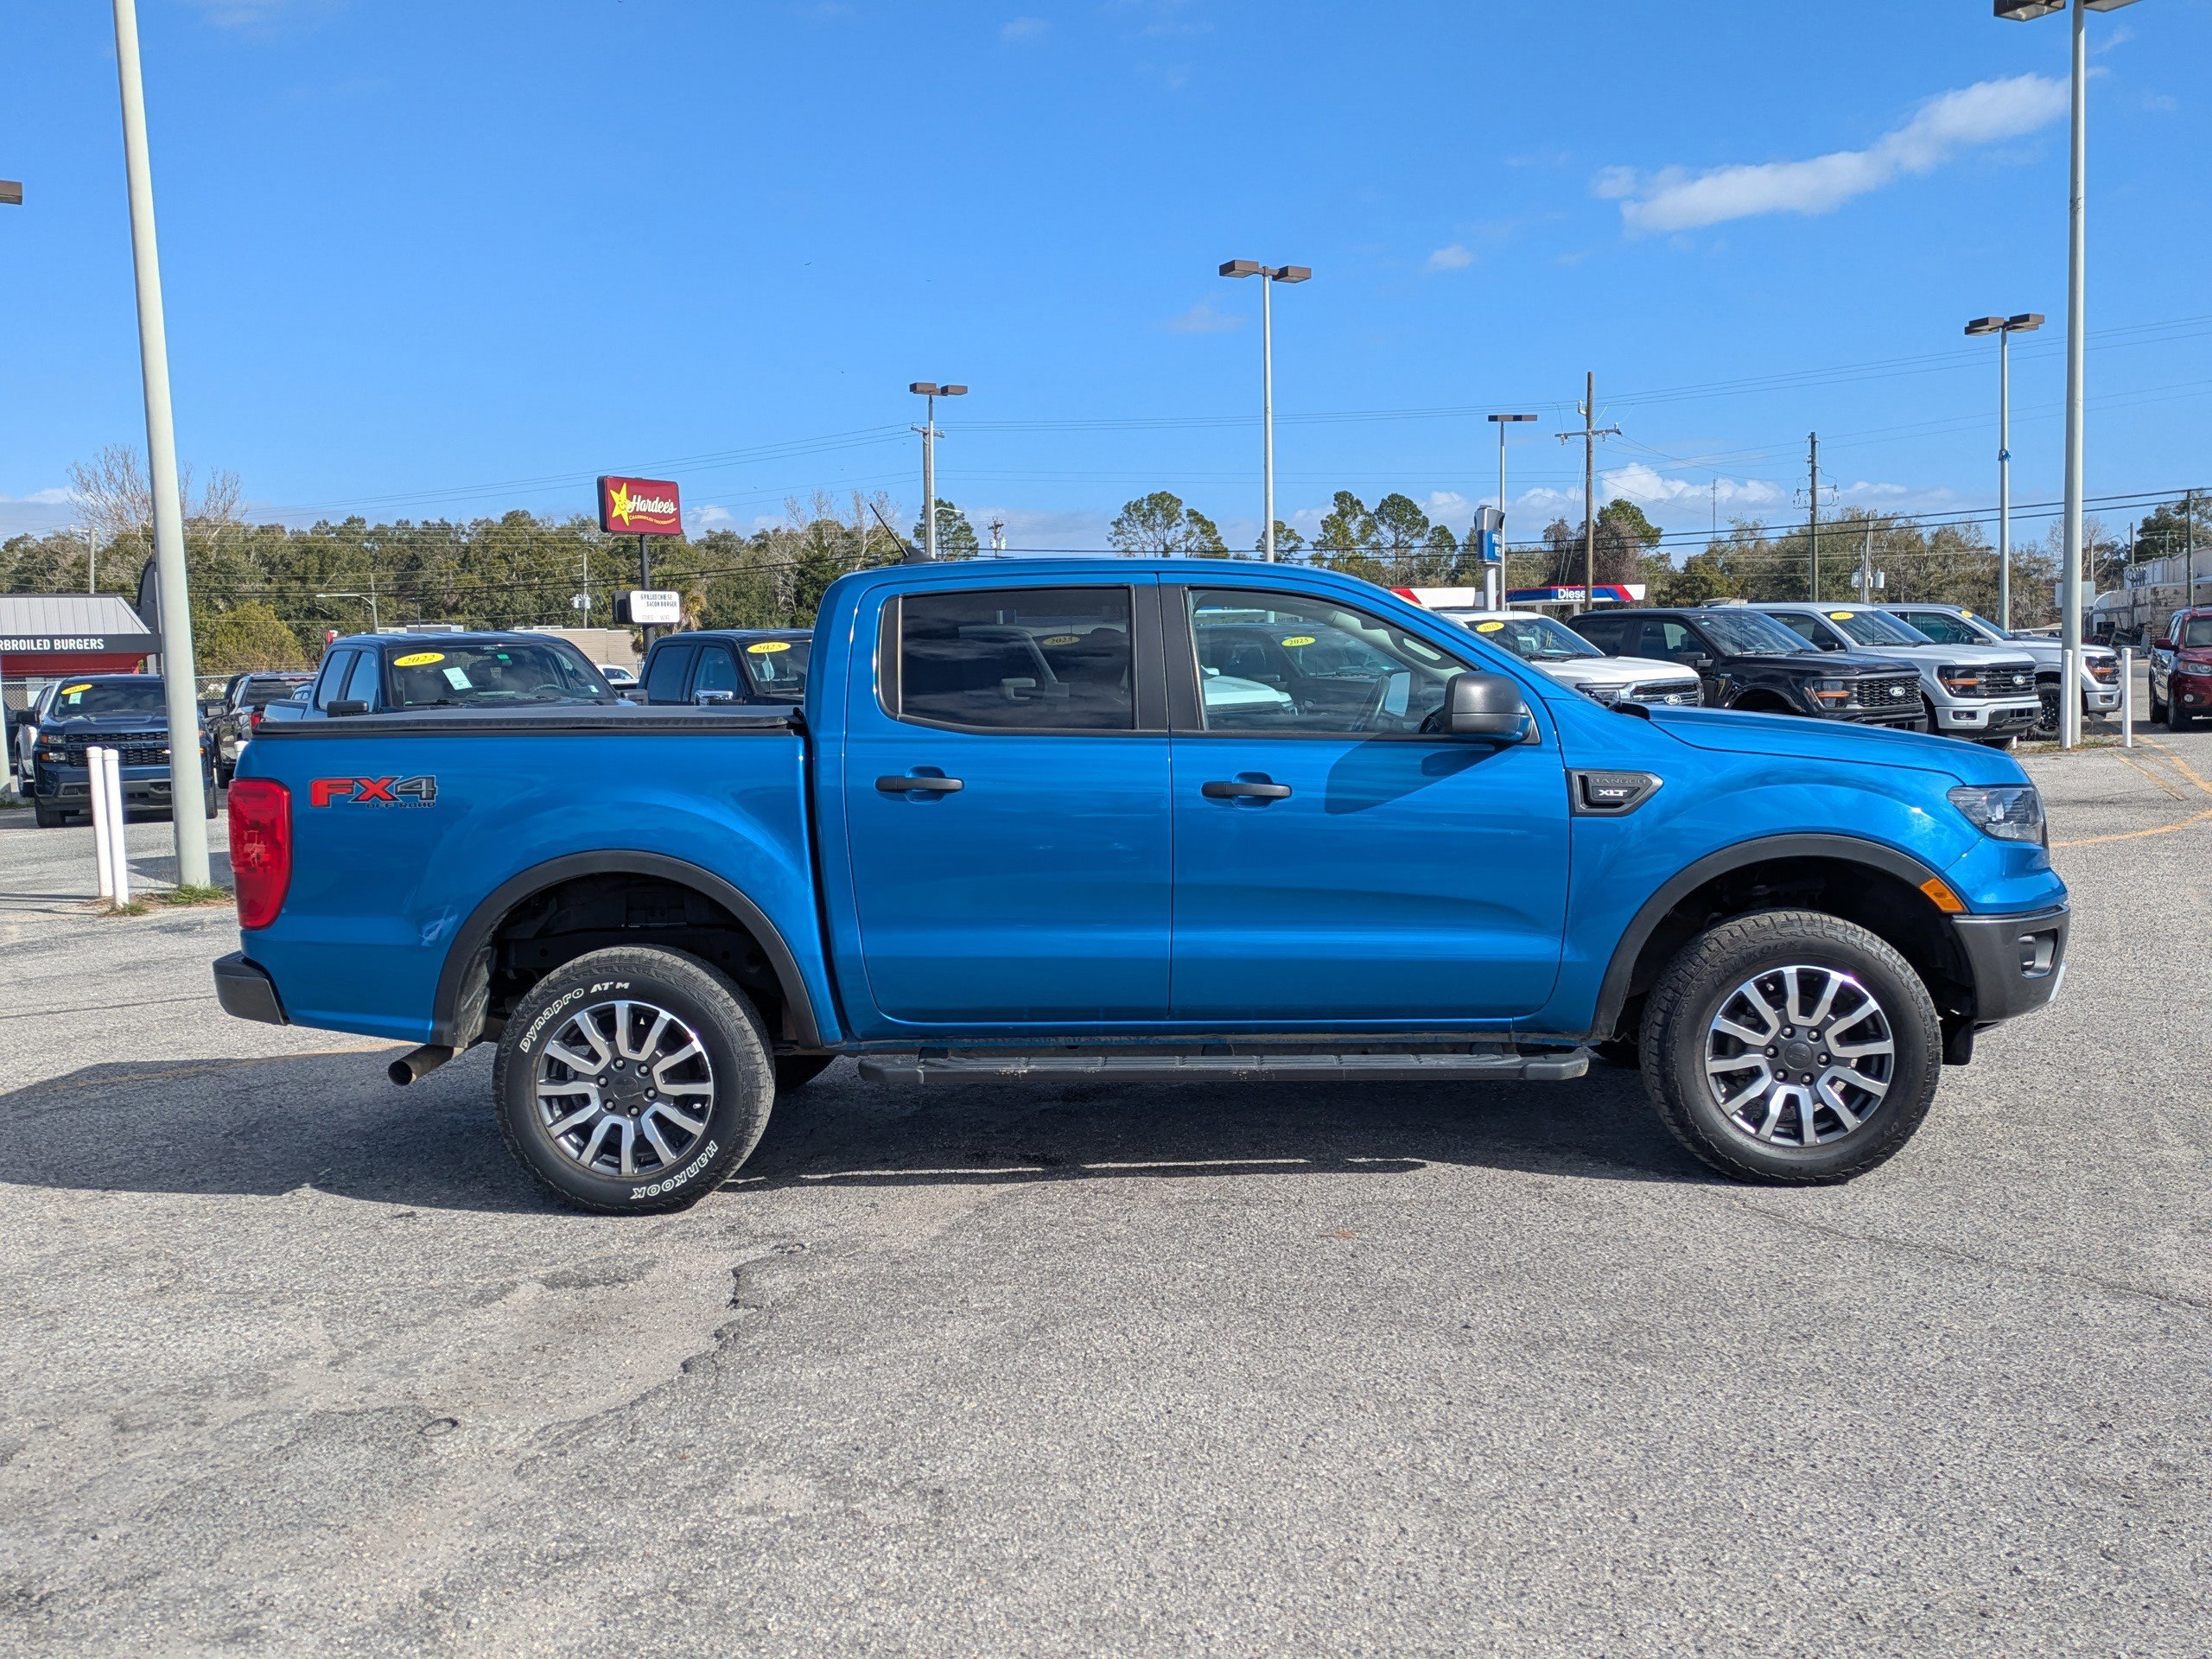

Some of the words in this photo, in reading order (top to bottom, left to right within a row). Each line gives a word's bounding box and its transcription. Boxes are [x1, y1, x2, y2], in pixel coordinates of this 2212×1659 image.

[626, 494, 677, 514] Hardee's
[1558, 588, 1586, 599] Diese
[54, 639, 104, 650] BURGERS
[404, 654, 435, 664] 2022
[309, 775, 438, 808] FX4
